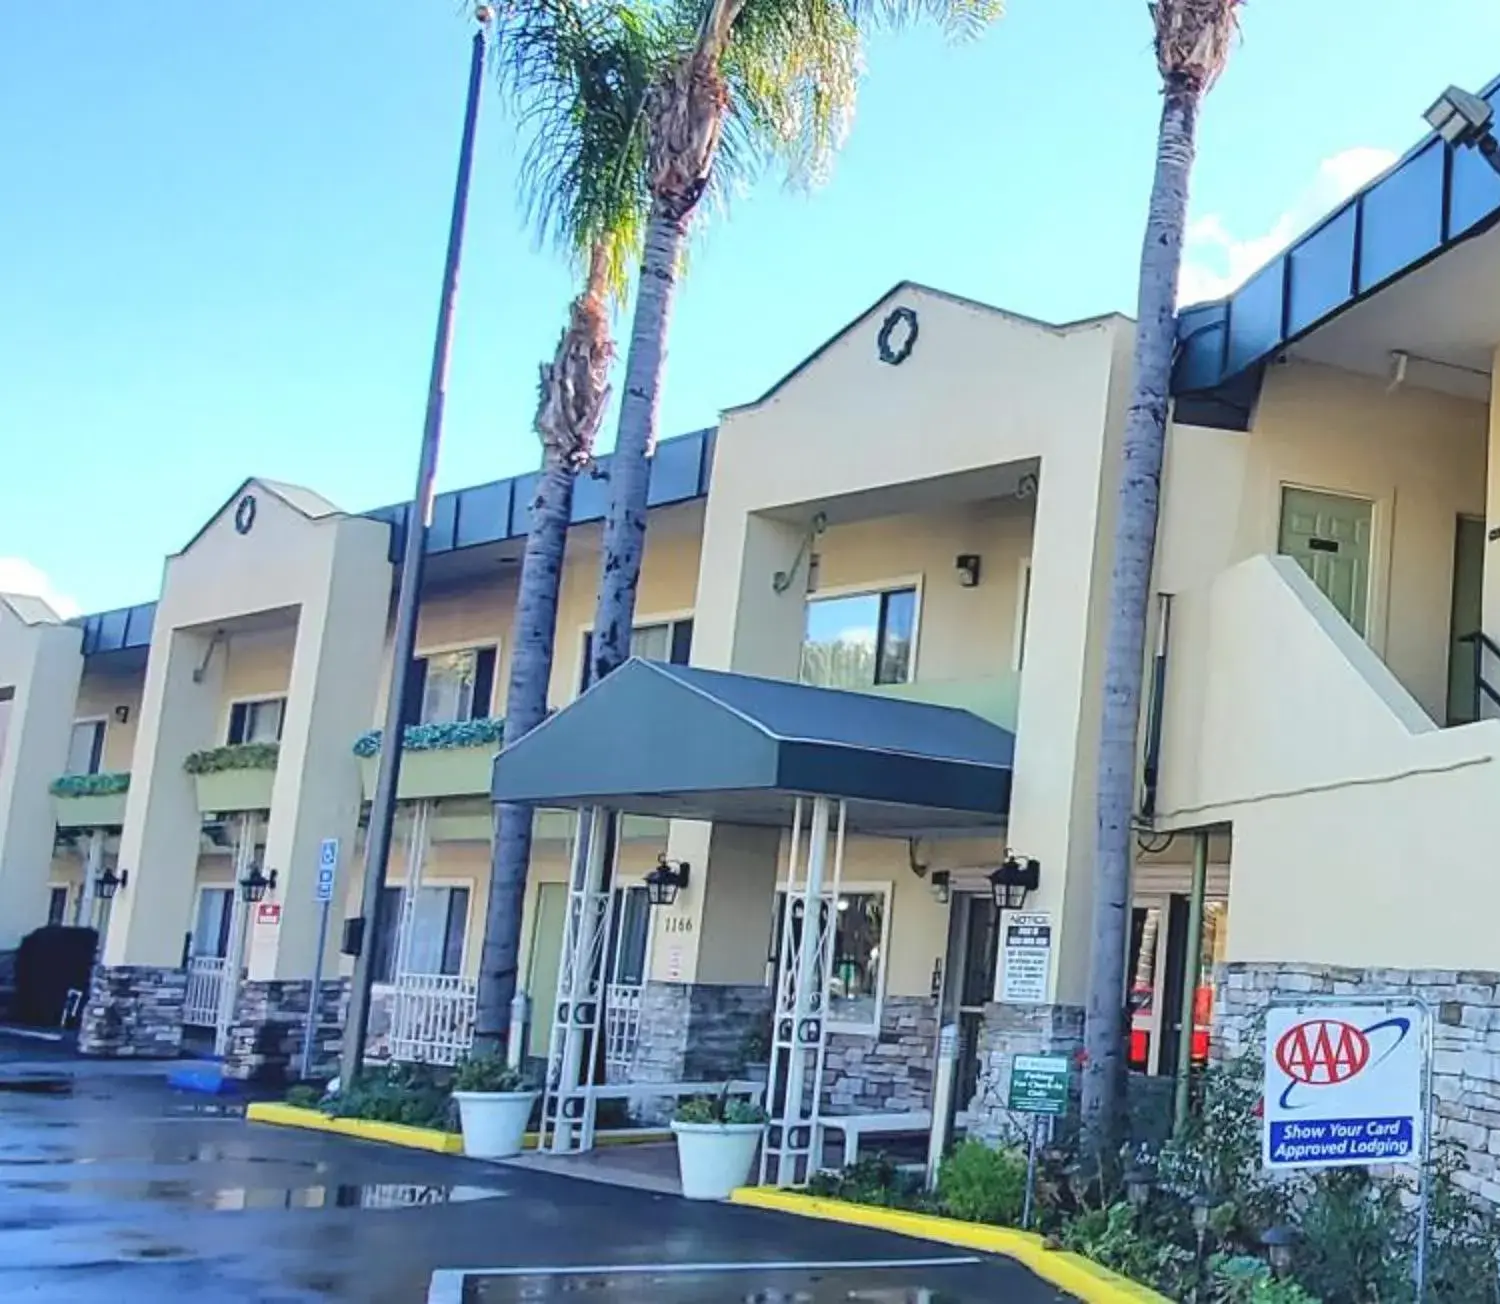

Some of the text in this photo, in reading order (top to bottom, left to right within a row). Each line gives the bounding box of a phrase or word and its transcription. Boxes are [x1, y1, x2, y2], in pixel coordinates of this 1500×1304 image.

[664, 916, 693, 933] 1166
[1286, 1021, 1363, 1083] AAA
[1283, 1119, 1401, 1140] Show Your Card
[1274, 1138, 1409, 1160] Approved Lodging
